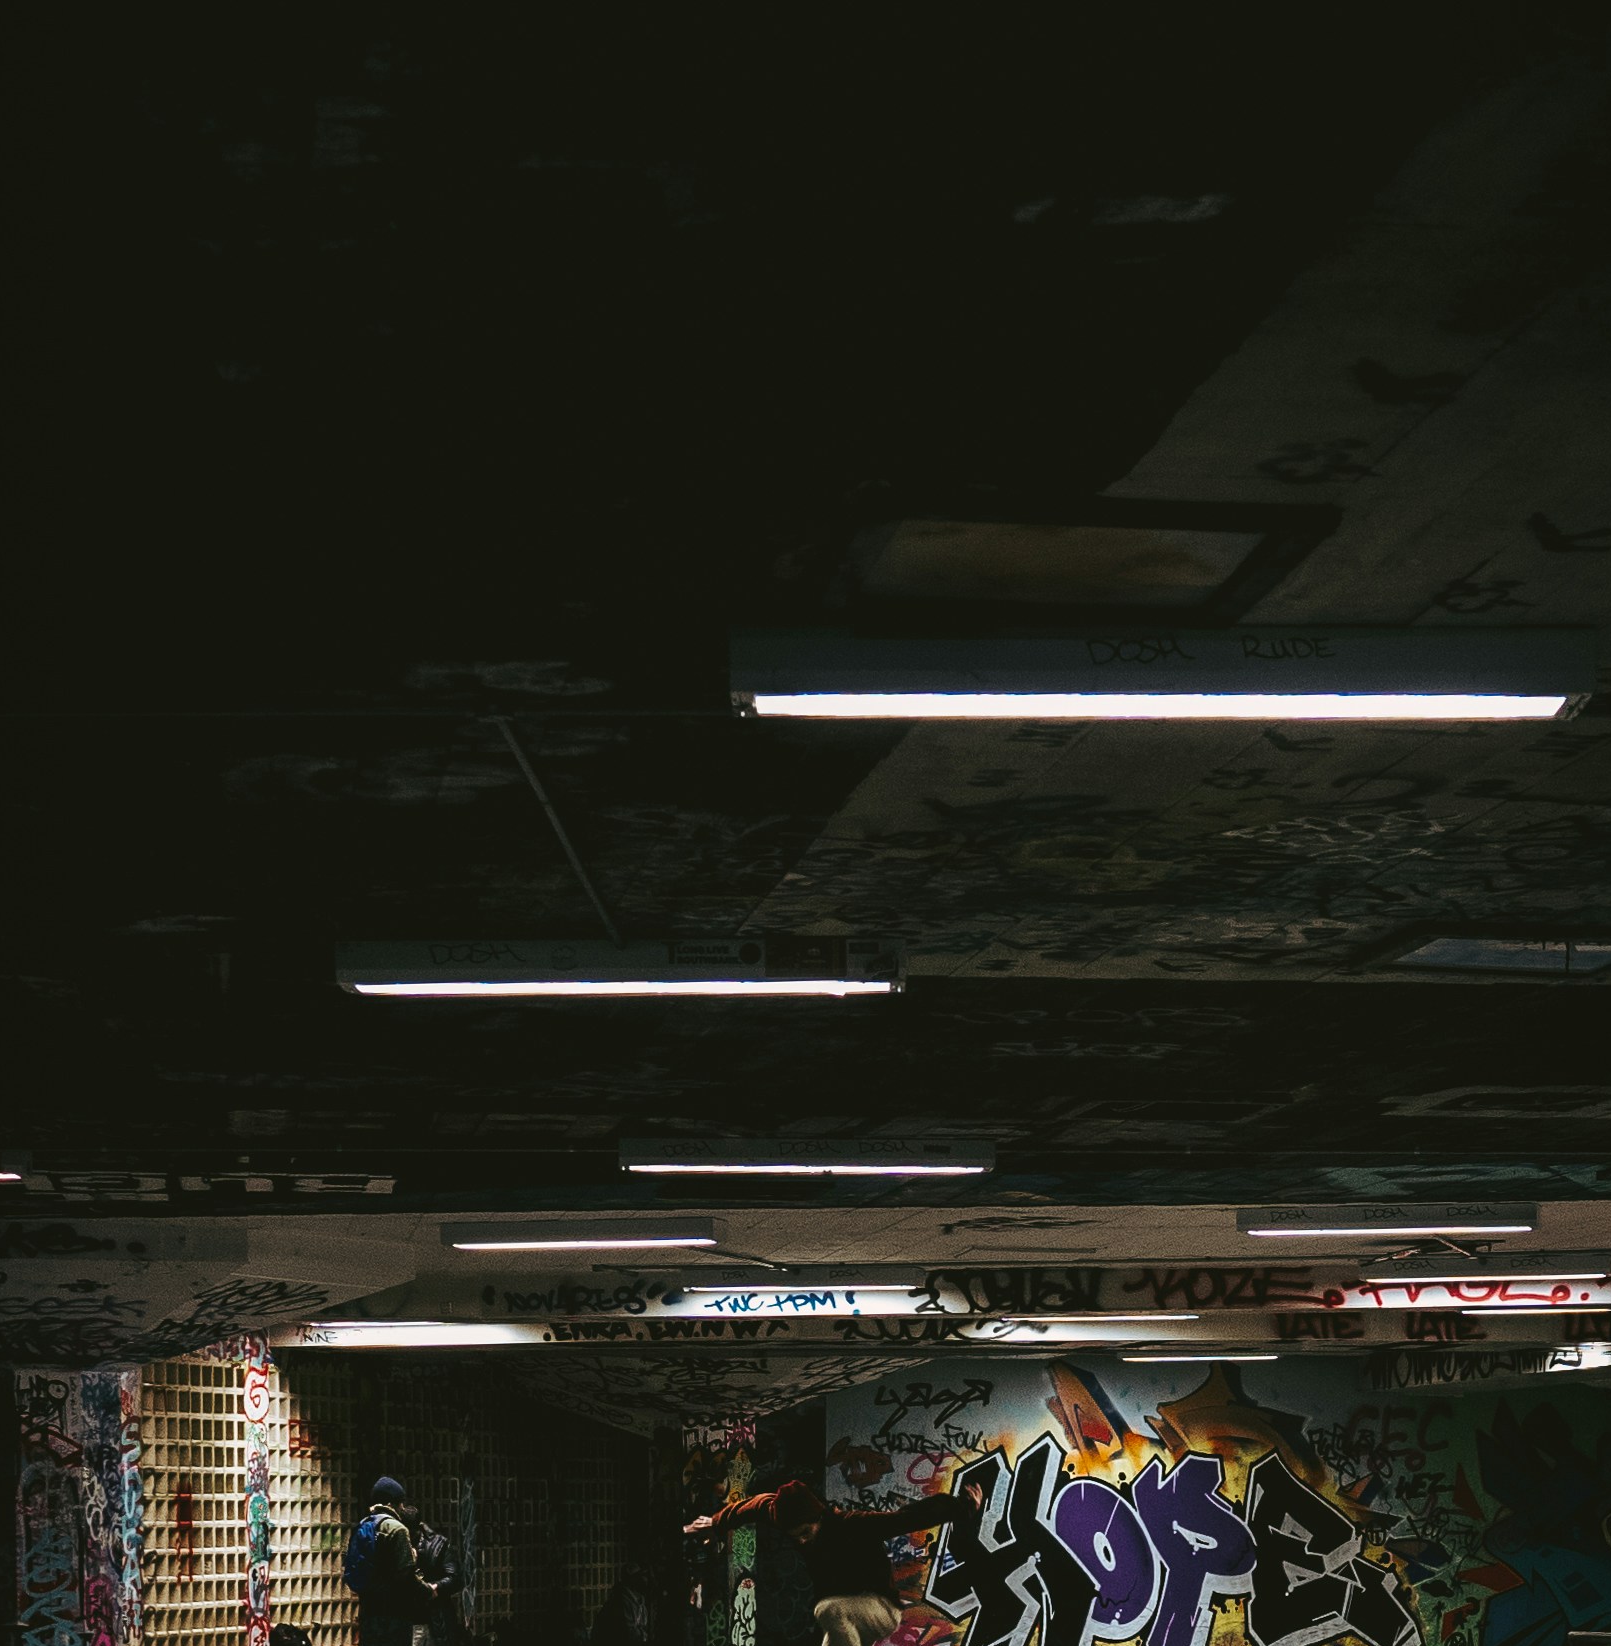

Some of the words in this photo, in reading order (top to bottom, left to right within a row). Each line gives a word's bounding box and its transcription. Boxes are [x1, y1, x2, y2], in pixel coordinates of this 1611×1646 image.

[1241, 634, 1337, 660] RUDE
[1273, 1311, 1365, 1340] LATE
[1405, 1311, 1488, 1341] LATE
